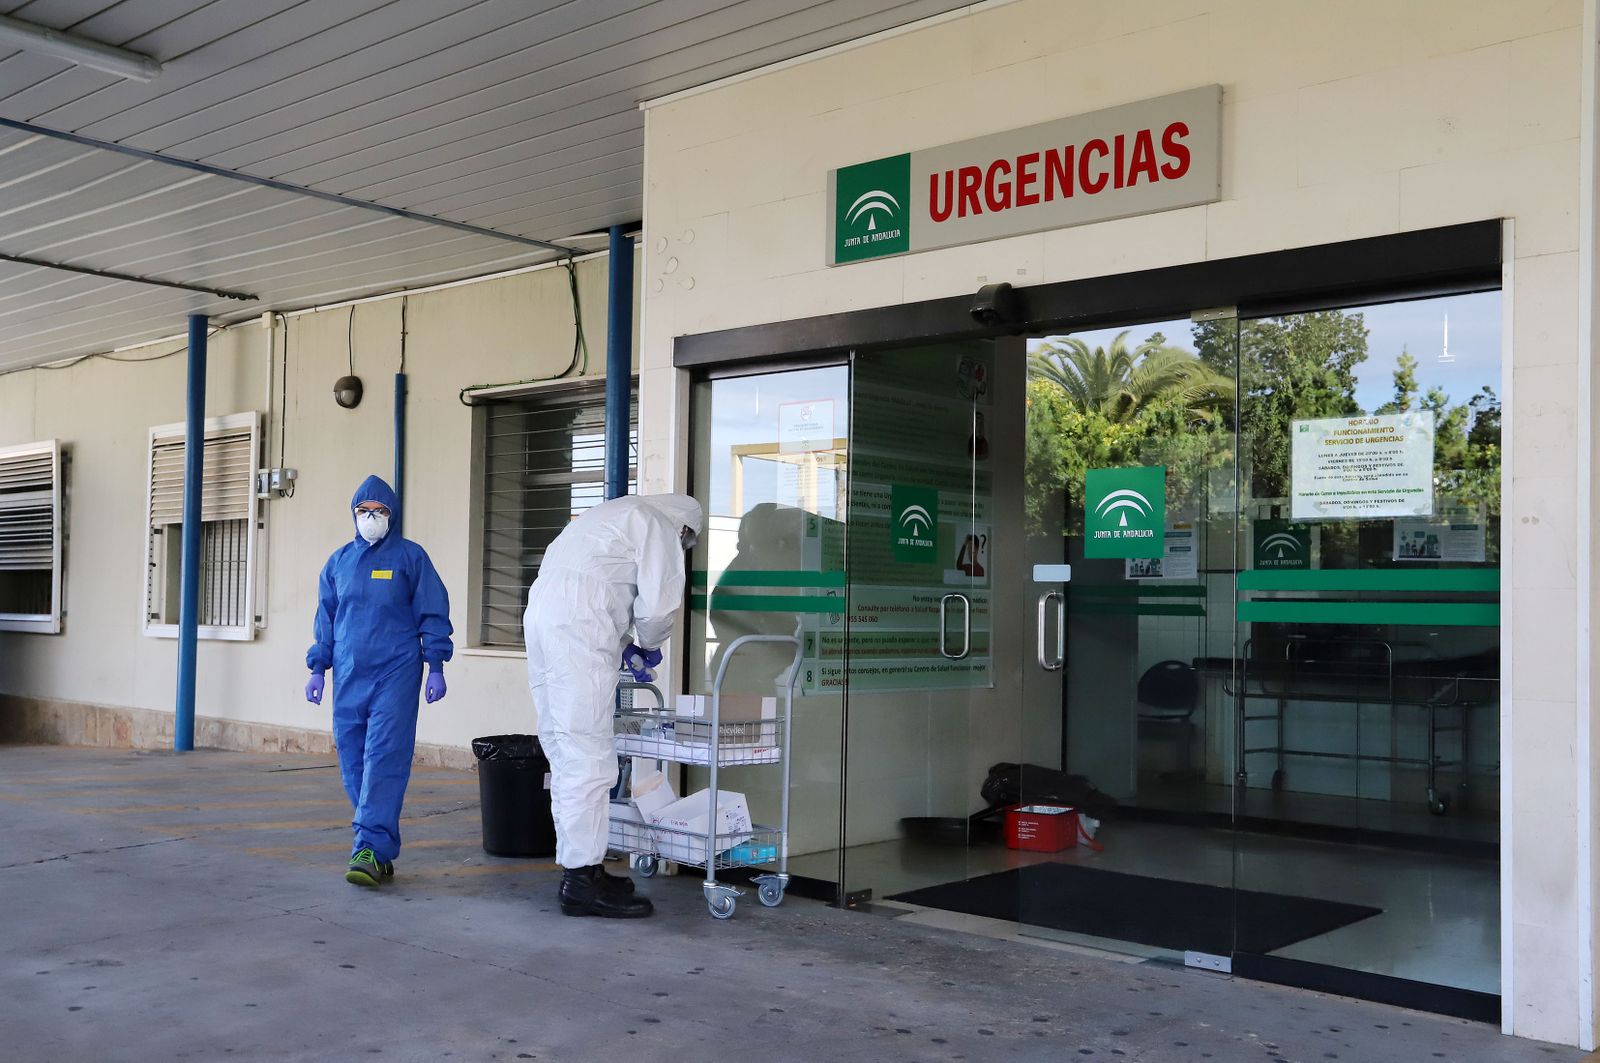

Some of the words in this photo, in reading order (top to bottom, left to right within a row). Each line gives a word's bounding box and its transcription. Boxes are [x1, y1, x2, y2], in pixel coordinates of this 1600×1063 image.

[929, 121, 1191, 223] URGENCIAS
[844, 235, 861, 248] JUNTA
[862, 234, 870, 245] DE
[1348, 418, 1379, 427] HORIO
[1333, 426, 1395, 437] FUNCIONAMIENTO
[1324, 438, 1354, 446] SERVICIO
[1355, 437, 1364, 445] DE
[1365, 435, 1405, 445] URGENCIAS
[809, 518, 817, 530] 5
[1094, 530, 1112, 538] JUNTA
[1113, 530, 1121, 538] DE
[858, 615, 868, 623] 545
[807, 638, 814, 651] 7
[806, 670, 813, 682] 8
[827, 668, 842, 676] sigue
[857, 666, 881, 676] consejos,
